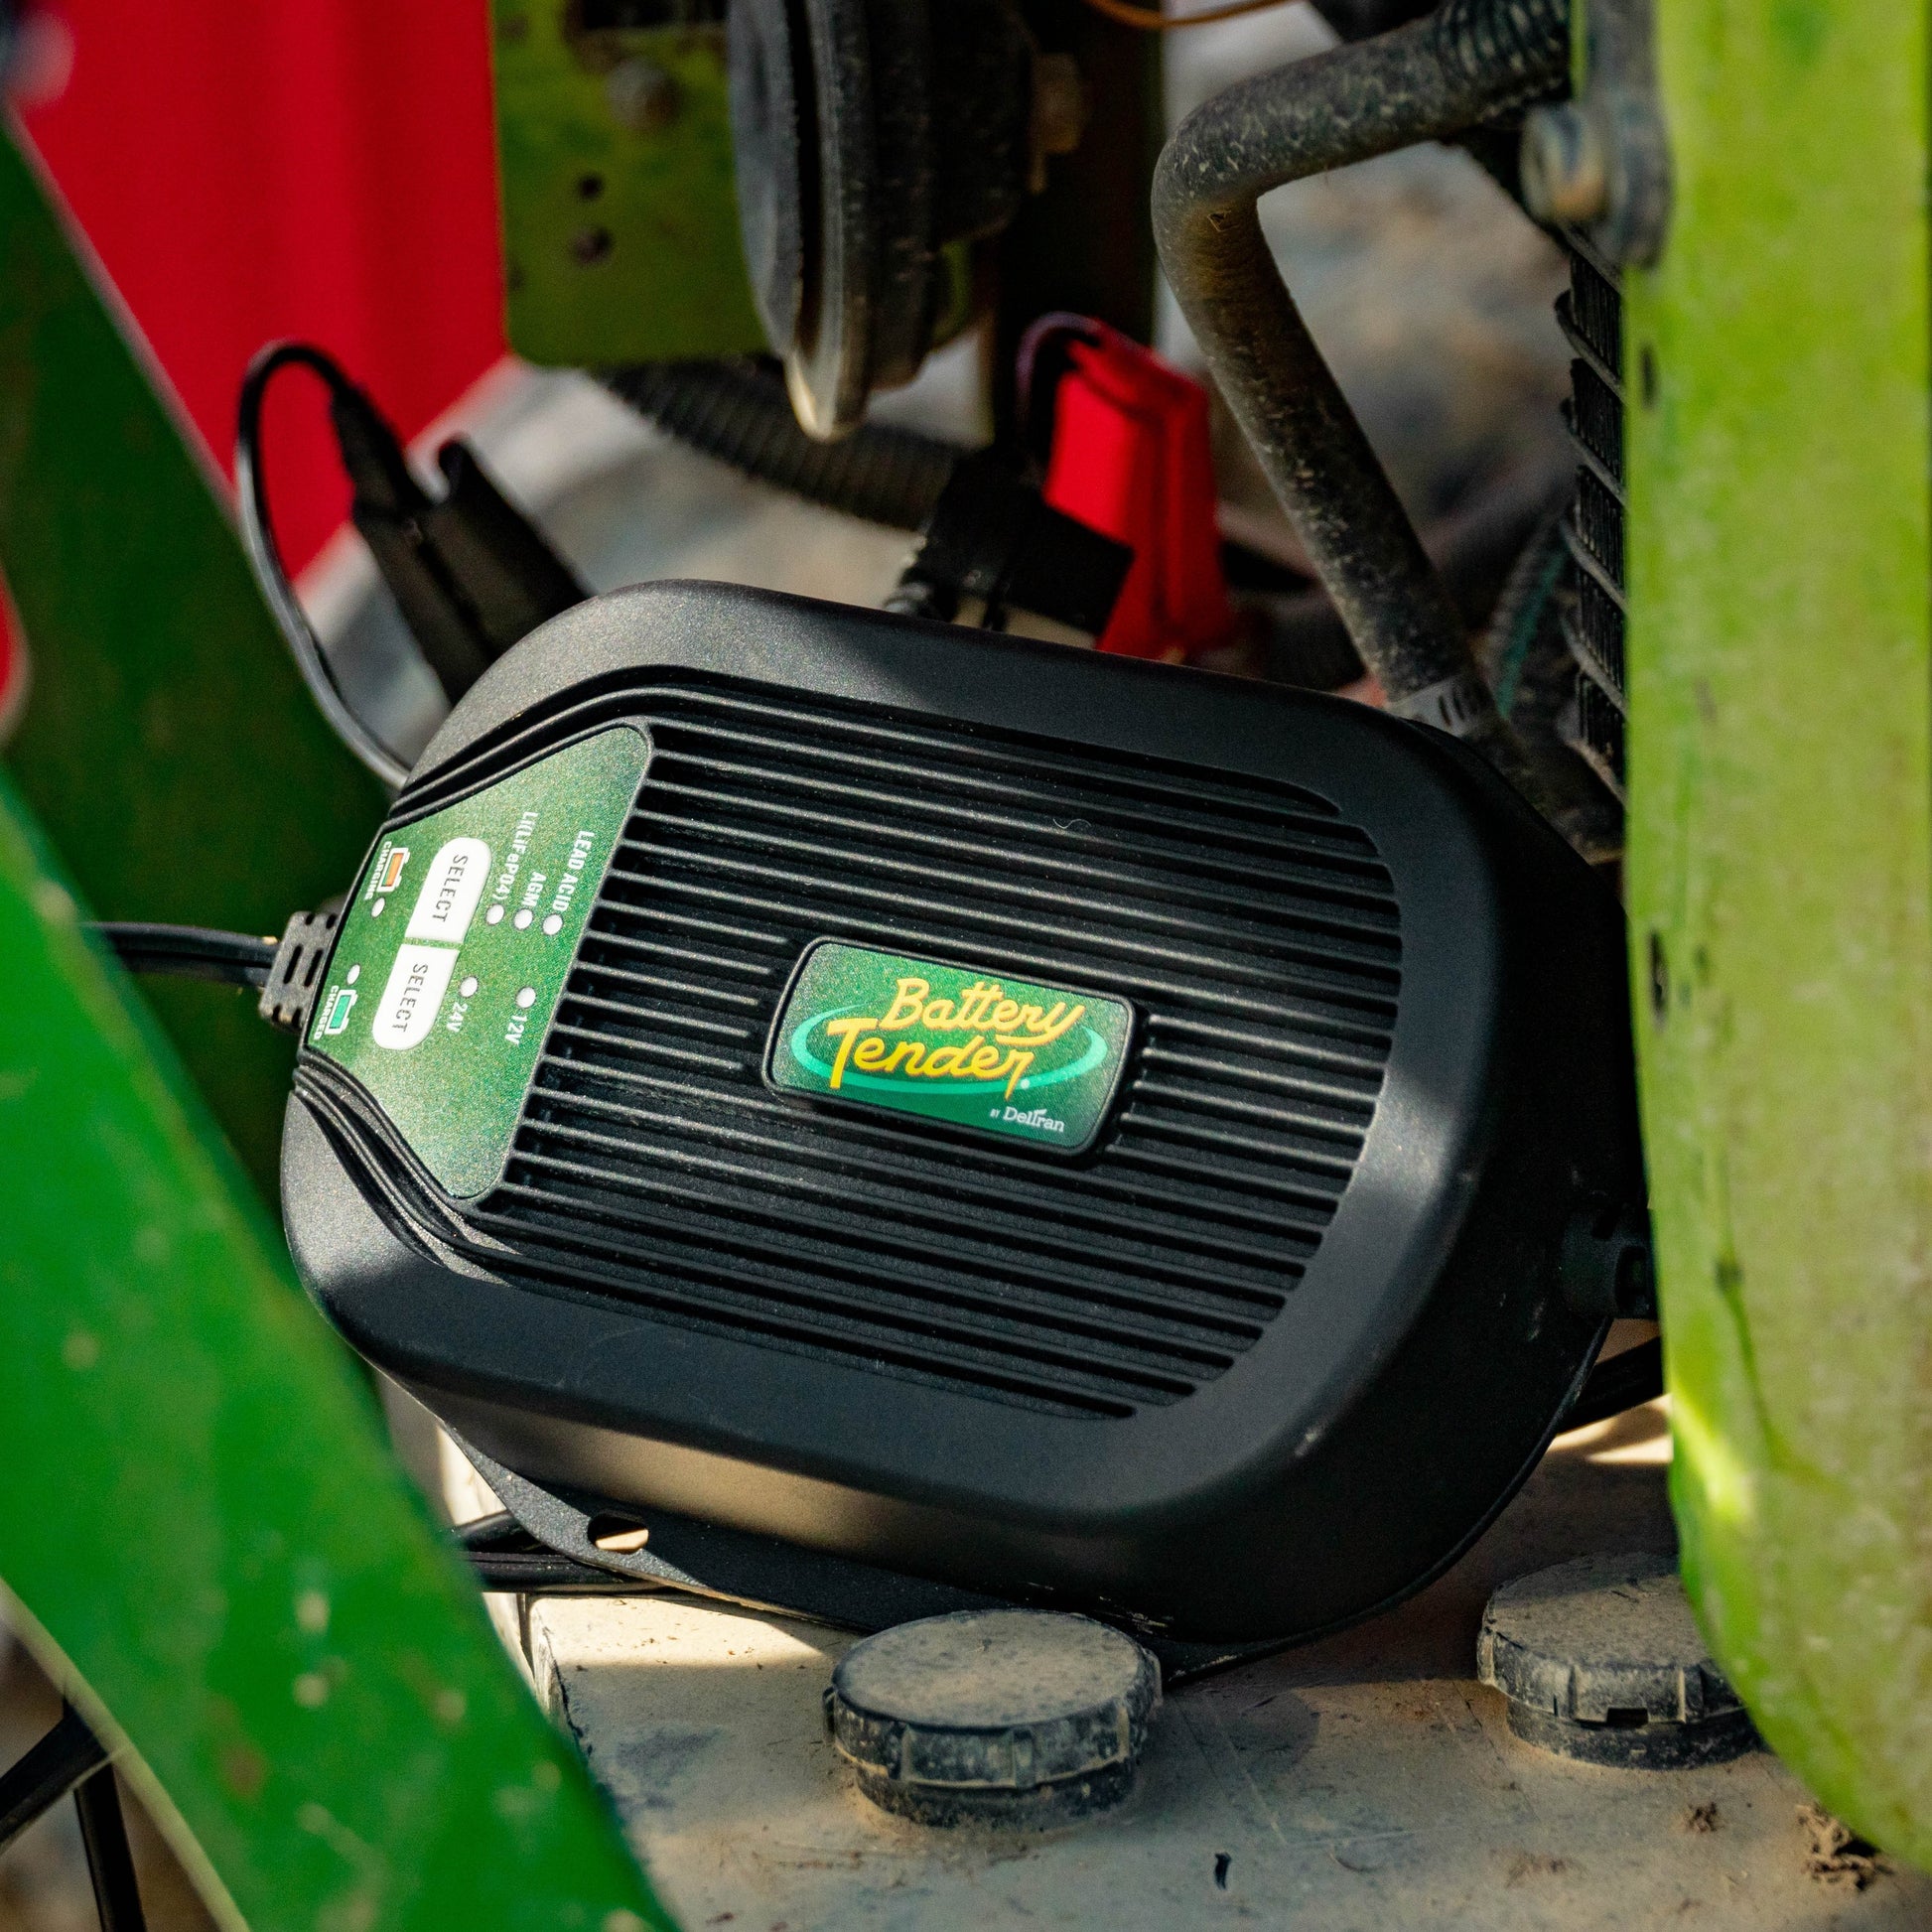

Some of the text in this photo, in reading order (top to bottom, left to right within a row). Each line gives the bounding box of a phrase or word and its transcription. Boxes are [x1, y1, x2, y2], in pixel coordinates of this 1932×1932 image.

[364, 841, 392, 900] CHARGING
[432, 854, 469, 923] SELECT
[522, 871, 547, 908] AGM
[552, 830, 595, 912] LEAD ACID
[314, 985, 340, 1040] CHARGED
[392, 962, 429, 1034] SELECT
[446, 1003, 468, 1034] 24V
[504, 1015, 528, 1045] 12V
[878, 977, 1086, 1046] Battery
[827, 1018, 1035, 1101] Tender
